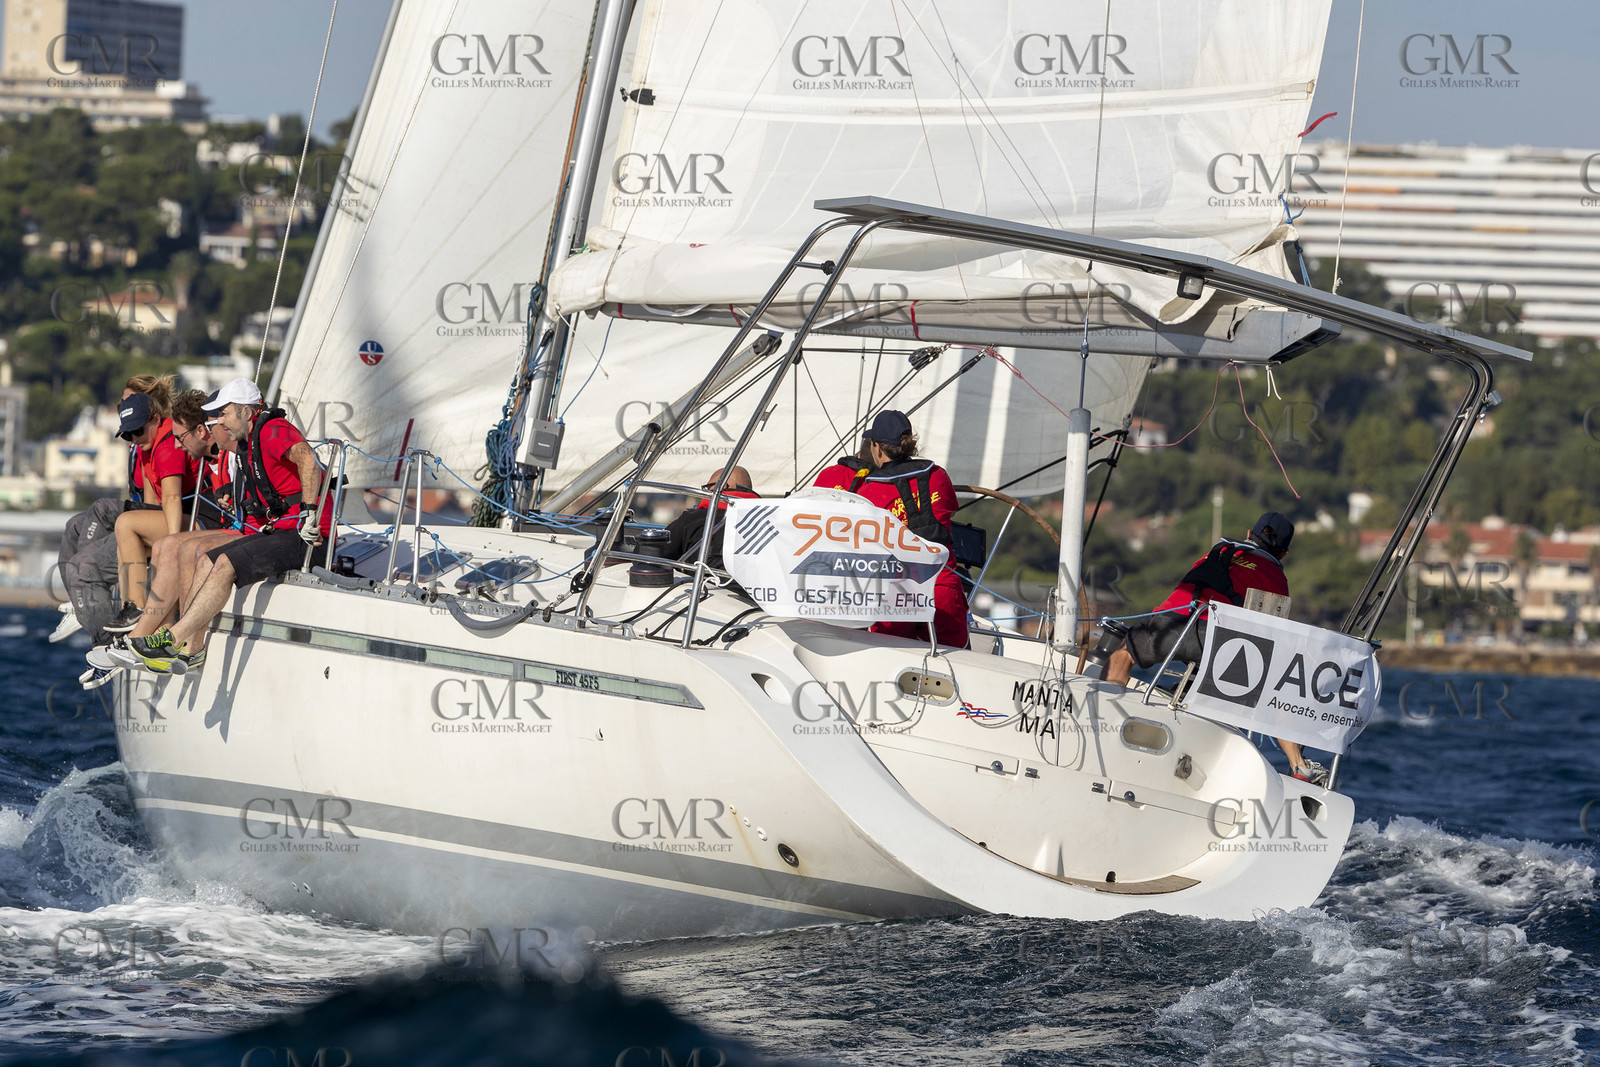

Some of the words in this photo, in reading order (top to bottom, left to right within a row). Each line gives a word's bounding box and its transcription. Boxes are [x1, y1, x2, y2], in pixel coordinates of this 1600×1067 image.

[87, 521, 98, 540] Gill
[833, 557, 904, 574] AVOCATS
[794, 588, 886, 607] GESTISOFT
[555, 669, 577, 687] FIRST
[579, 673, 600, 690] 45F5
[1273, 652, 1364, 710] ACE
[1012, 681, 1073, 714] MANTA
[1267, 696, 1318, 722] Avocats,
[1019, 713, 1056, 740] MA
